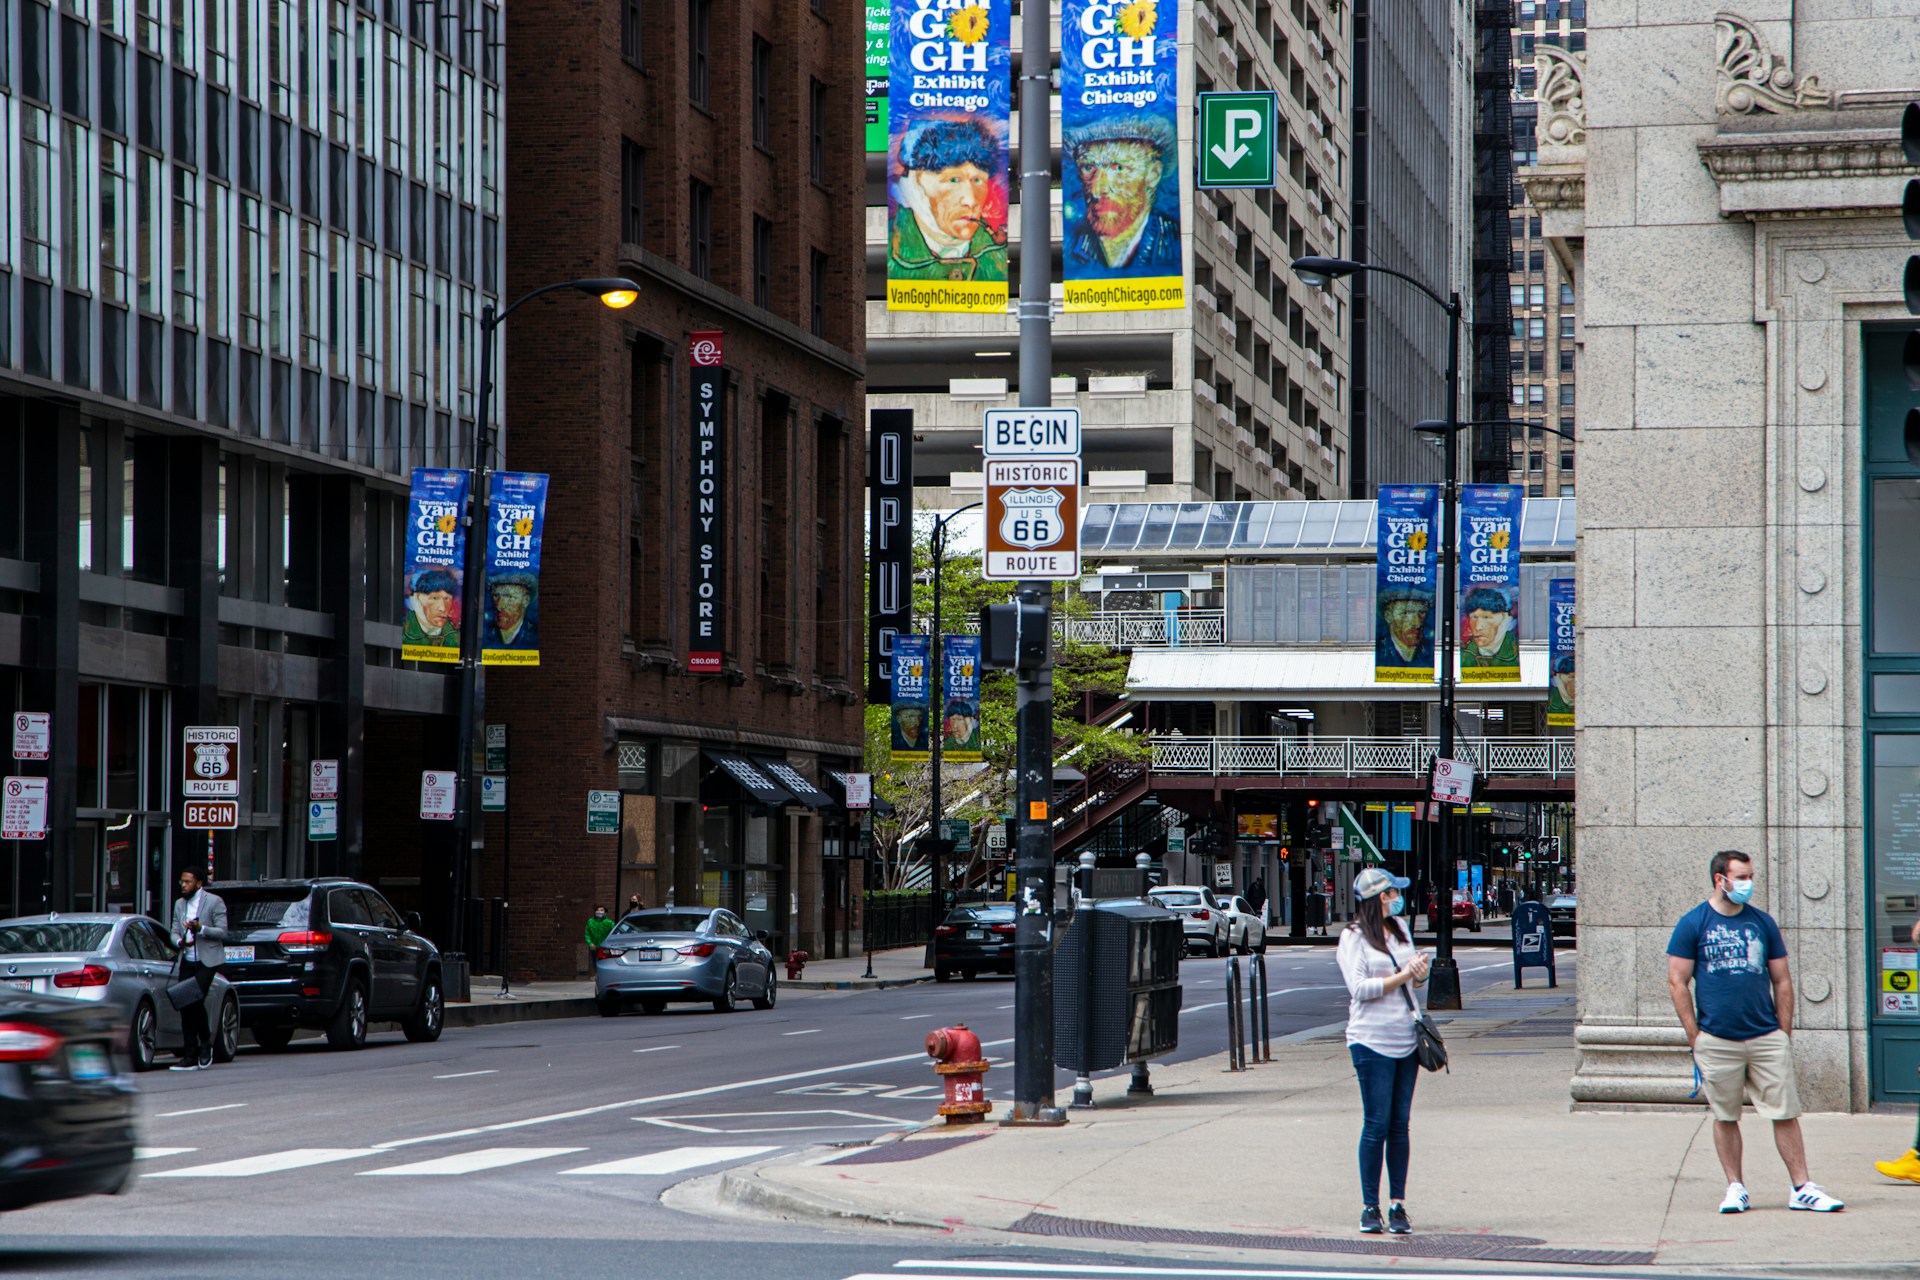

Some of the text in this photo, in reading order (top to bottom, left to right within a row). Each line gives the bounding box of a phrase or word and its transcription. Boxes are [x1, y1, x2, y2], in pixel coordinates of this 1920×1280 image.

[910, 42, 989, 72] GH
[1082, 36, 1157, 69] GH
[913, 75, 985, 89] Exhibit
[1084, 70, 1154, 87] Exhibit
[910, 92, 989, 112] Chicago
[1081, 90, 1157, 108] Chicago
[891, 288, 1006, 308] VanGoghChicago.com
[1066, 286, 1182, 304] VanGoghChicago.com
[997, 420, 1067, 445] BEGIN
[996, 467, 1068, 481] HISTORIC
[1010, 496, 1053, 504] ILLINOIS
[699, 382, 714, 638] SYMPHONY STORE
[1014, 521, 1048, 541] 66
[417, 531, 455, 547] GH
[496, 534, 532, 550] GH
[418, 547, 453, 555] Exhibit
[1388, 549, 1427, 564] GH
[1470, 548, 1509, 564] GH
[416, 556, 454, 566] Chicago
[495, 559, 530, 569] Chicago
[1007, 557, 1057, 570] ROUTE
[1387, 575, 1426, 584] Chicago
[1470, 574, 1508, 583] Chicago
[404, 649, 458, 660] VanGoghChicago.com
[484, 654, 538, 663] VanGoghChicago.com
[1462, 671, 1520, 680] VanGoghChicago.com
[188, 732, 236, 740] HISTORIC
[202, 762, 221, 774] 66
[194, 783, 229, 791] ROUTE
[189, 807, 232, 822] BEGIN
[991, 837, 1006, 846] 66
